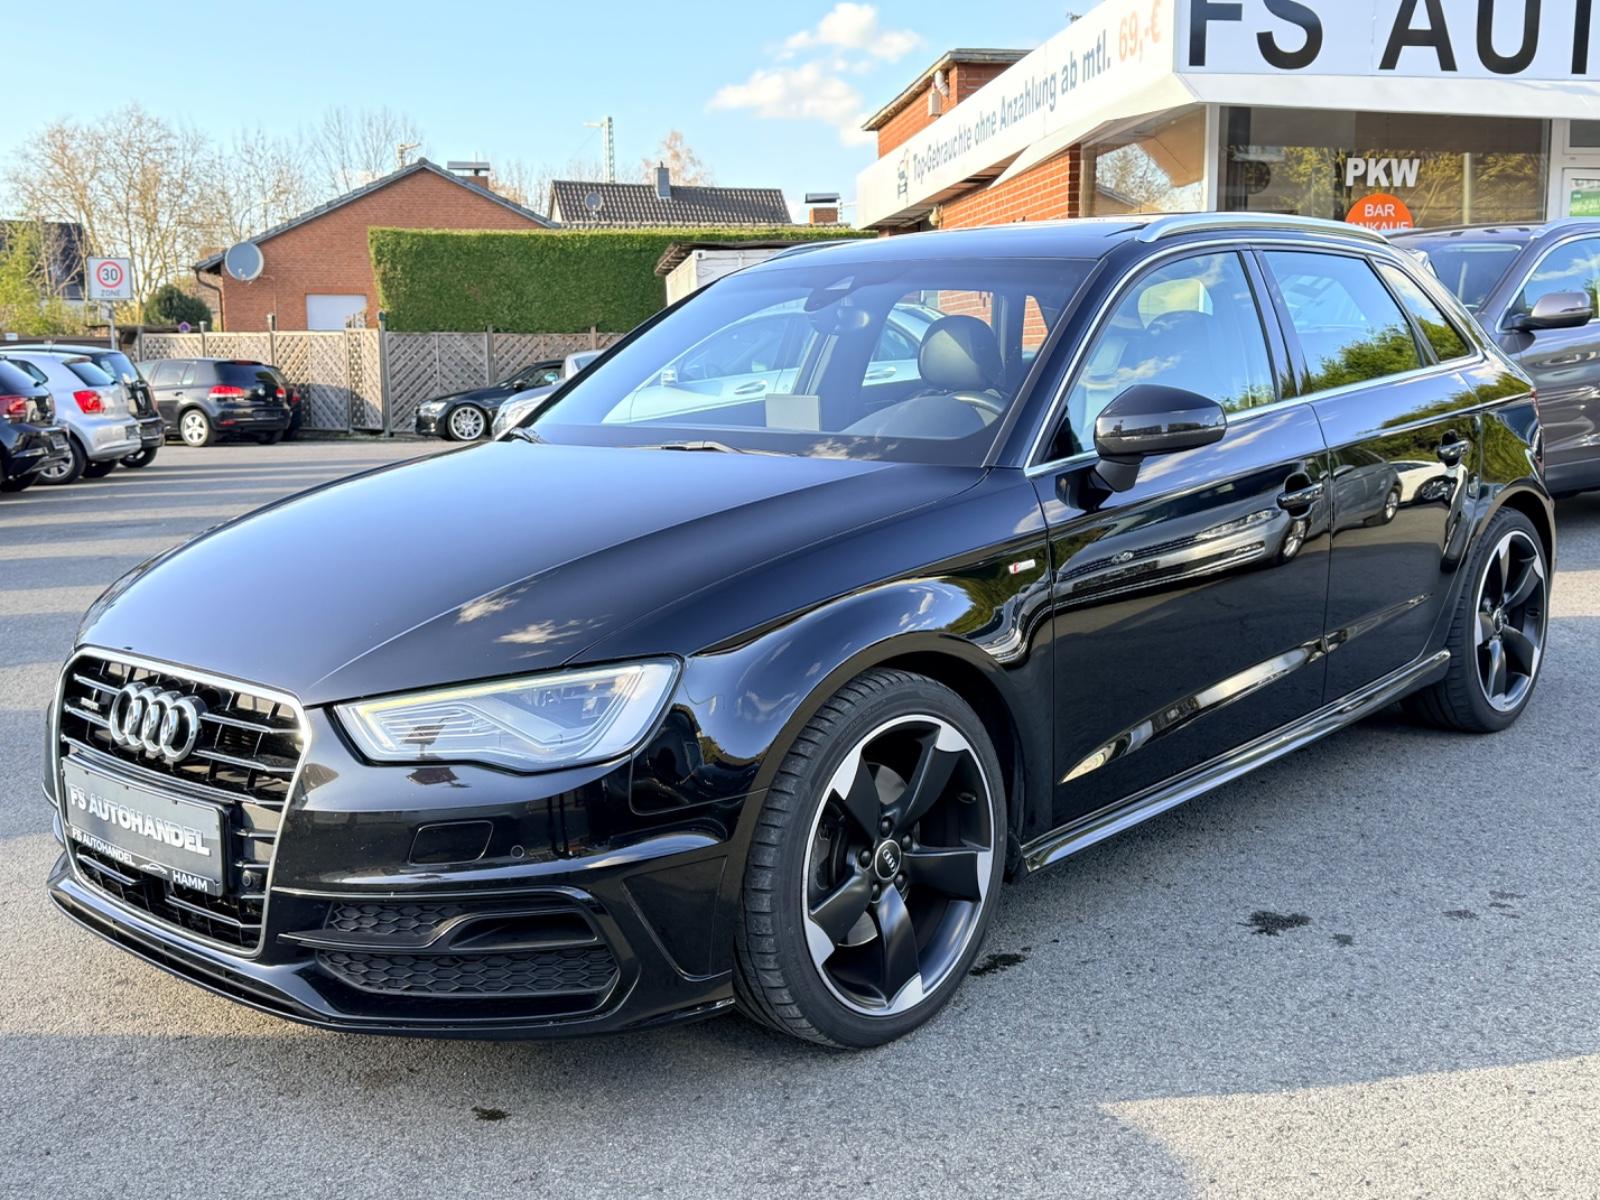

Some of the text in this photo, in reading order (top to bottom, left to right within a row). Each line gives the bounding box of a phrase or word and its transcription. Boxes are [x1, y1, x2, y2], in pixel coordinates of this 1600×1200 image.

[1188, 0, 1323, 70] FS
[974, 110, 997, 146] ohne
[1000, 72, 1057, 131] Anzahlung
[1061, 50, 1077, 95] ab
[1082, 29, 1111, 83] mtl.
[1345, 157, 1420, 187] PKW
[1364, 204, 1395, 217] BAR
[102, 268, 118, 281] 30
[101, 289, 120, 297] ZONE
[70, 784, 211, 857] FS AUTOHANDEL
[72, 828, 137, 867] FS AUTOHANDEL
[172, 870, 208, 892] HAMM
